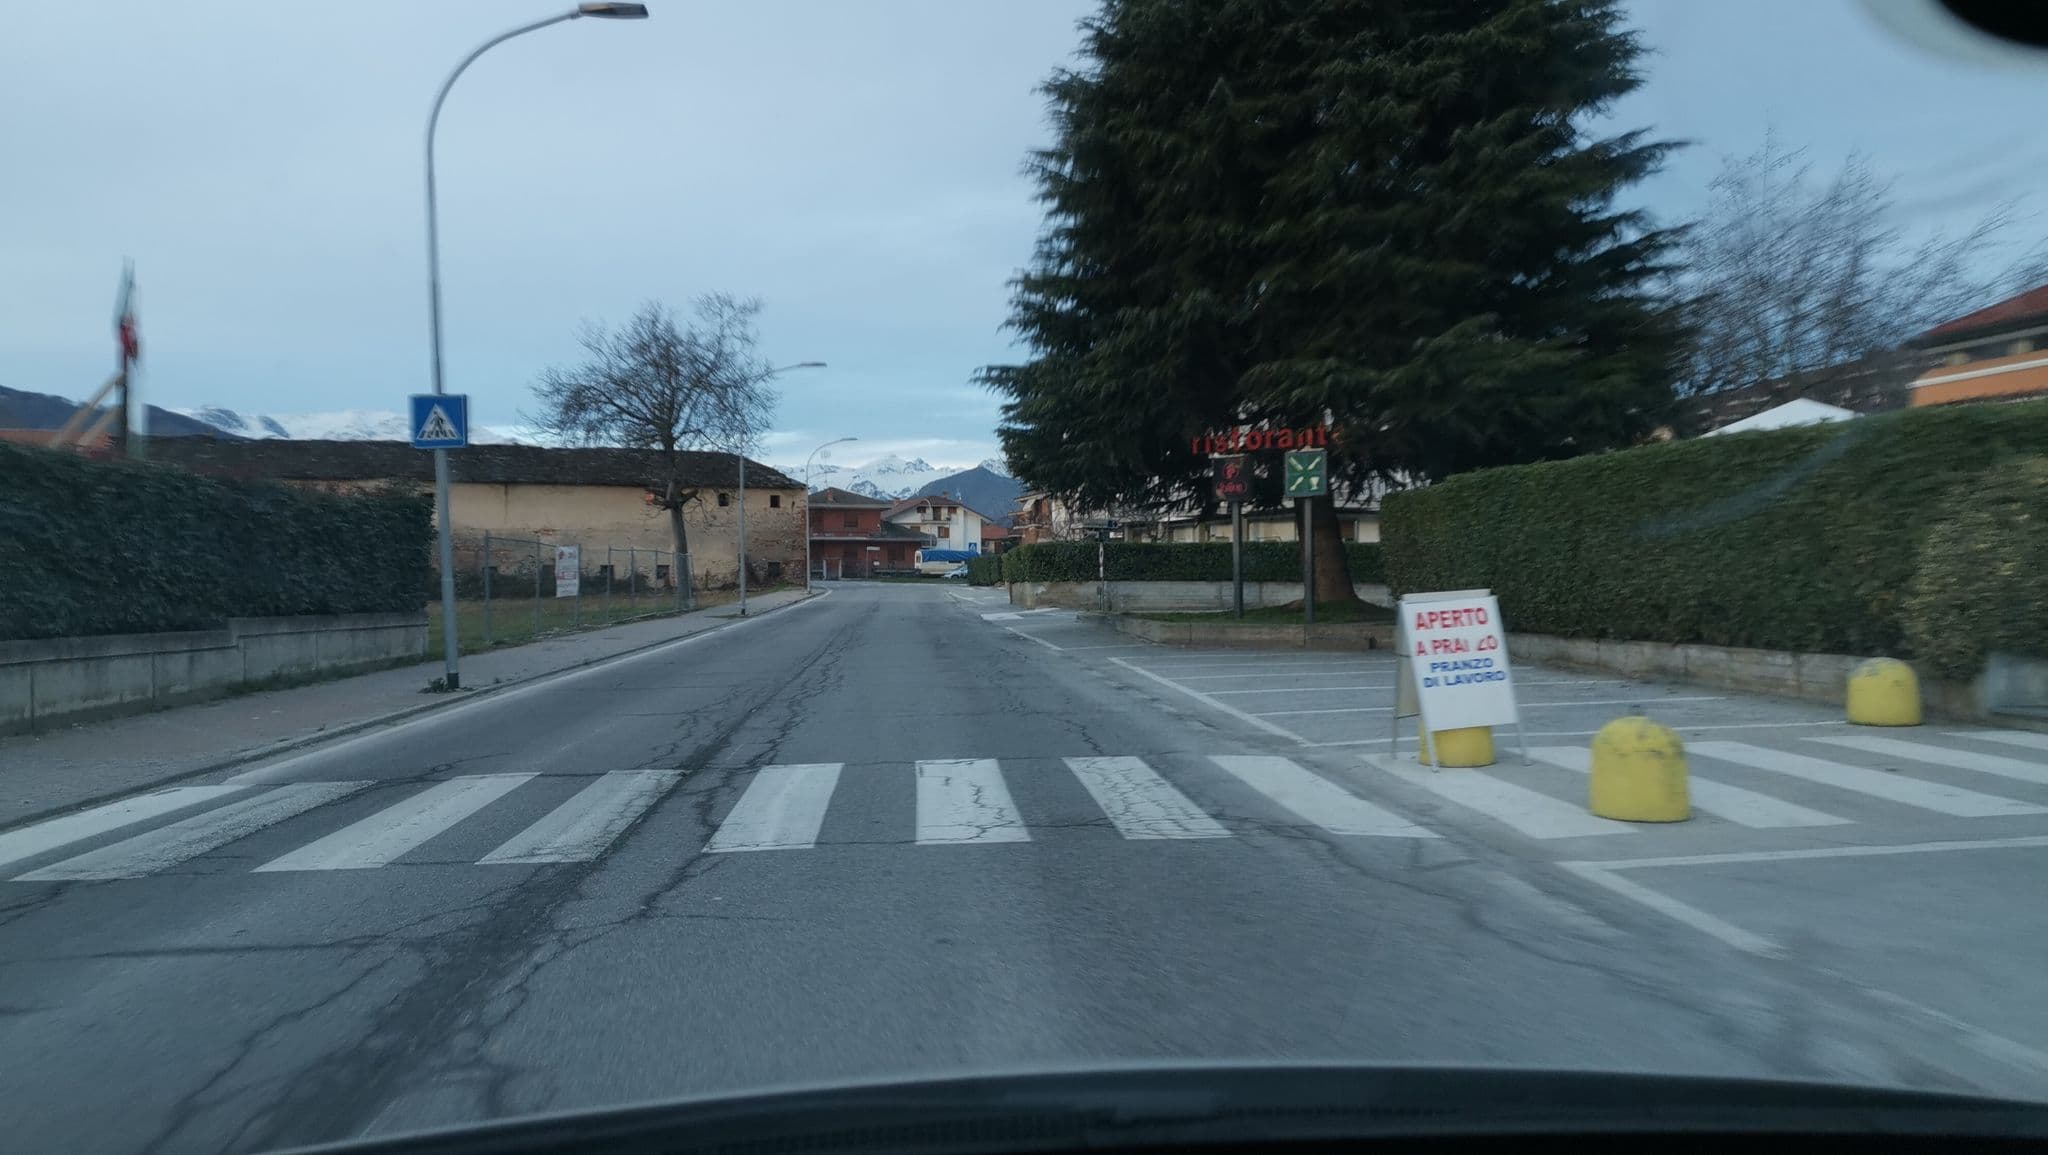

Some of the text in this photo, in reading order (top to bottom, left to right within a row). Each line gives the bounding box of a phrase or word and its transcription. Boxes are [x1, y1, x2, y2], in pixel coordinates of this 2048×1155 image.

[1190, 425, 1342, 455] ristorant
[1416, 607, 1488, 630] APERTO
[1416, 641, 1427, 656] A
[1430, 658, 1494, 673] PRANZO
[1423, 670, 1505, 688] DI LAVORO
